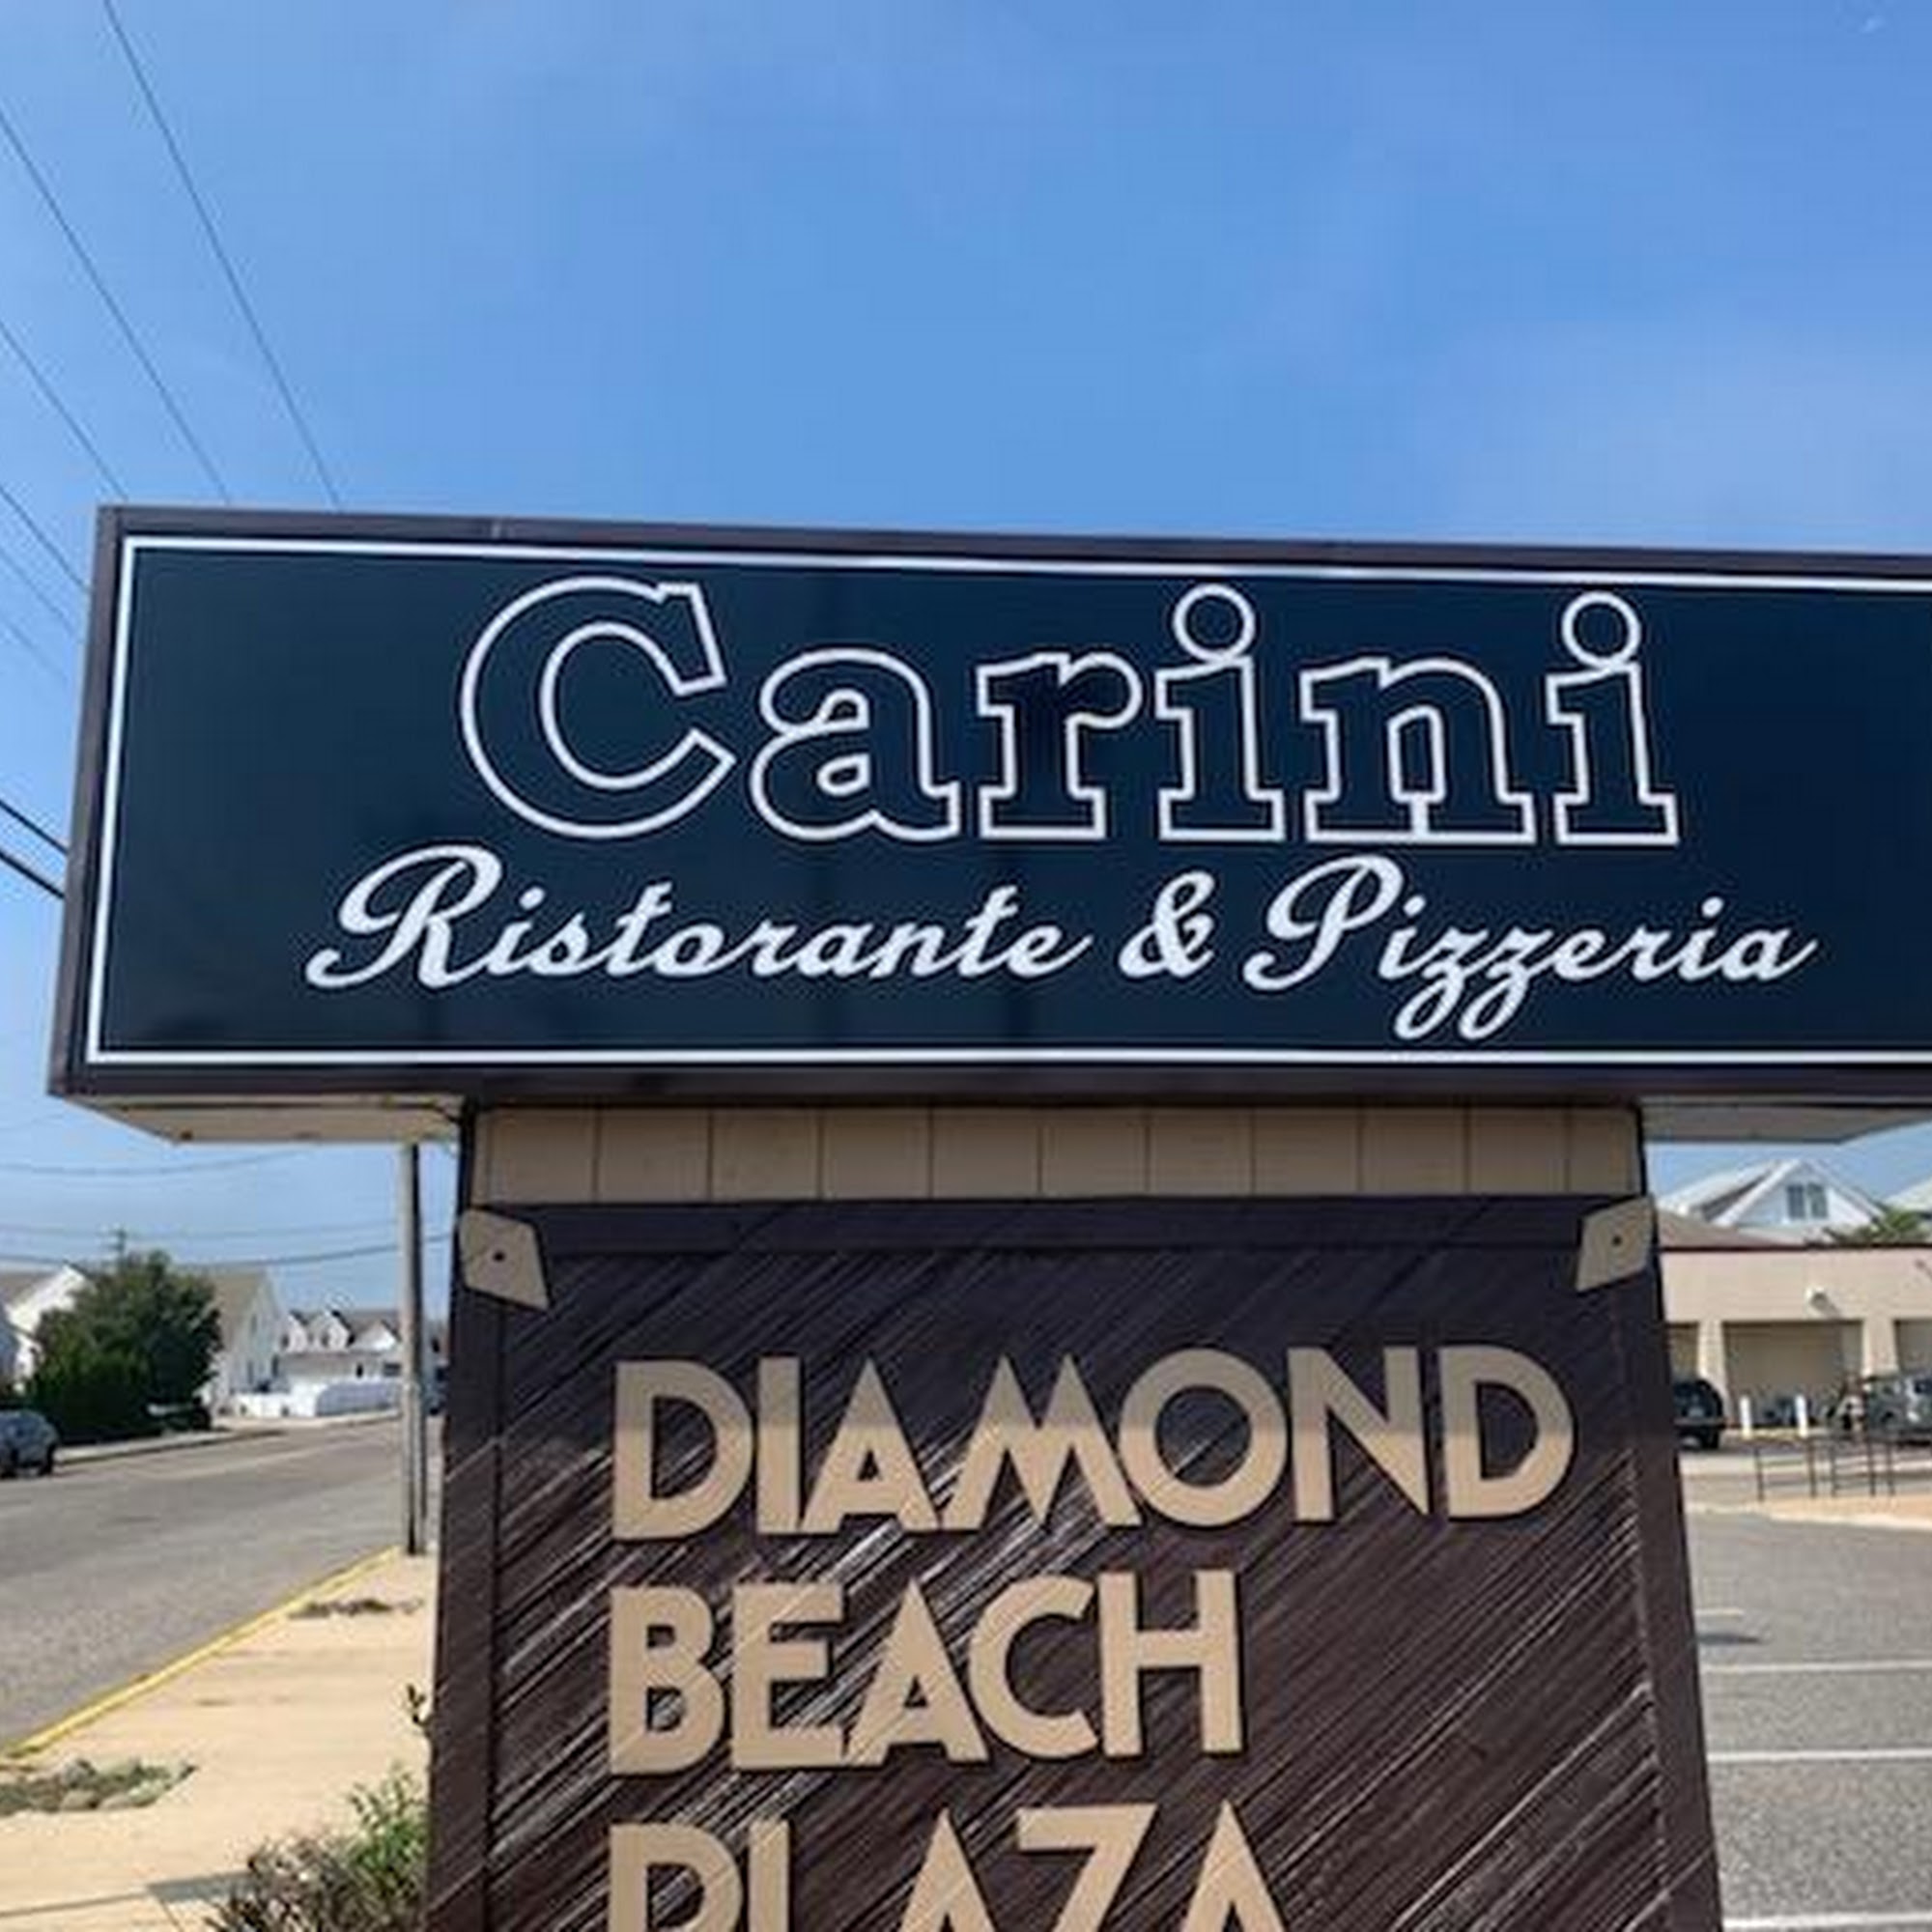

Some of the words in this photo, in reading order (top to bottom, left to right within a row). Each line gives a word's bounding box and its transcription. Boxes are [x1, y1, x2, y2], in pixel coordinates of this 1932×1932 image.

[460, 577, 1681, 846] Carini
[305, 843, 1094, 990] Ristorante
[1118, 870, 1215, 980] &
[1242, 853, 1818, 1040] Pizzeria
[611, 1346, 1576, 1541] DIAMOND
[608, 1569, 1243, 1776] BEACH
